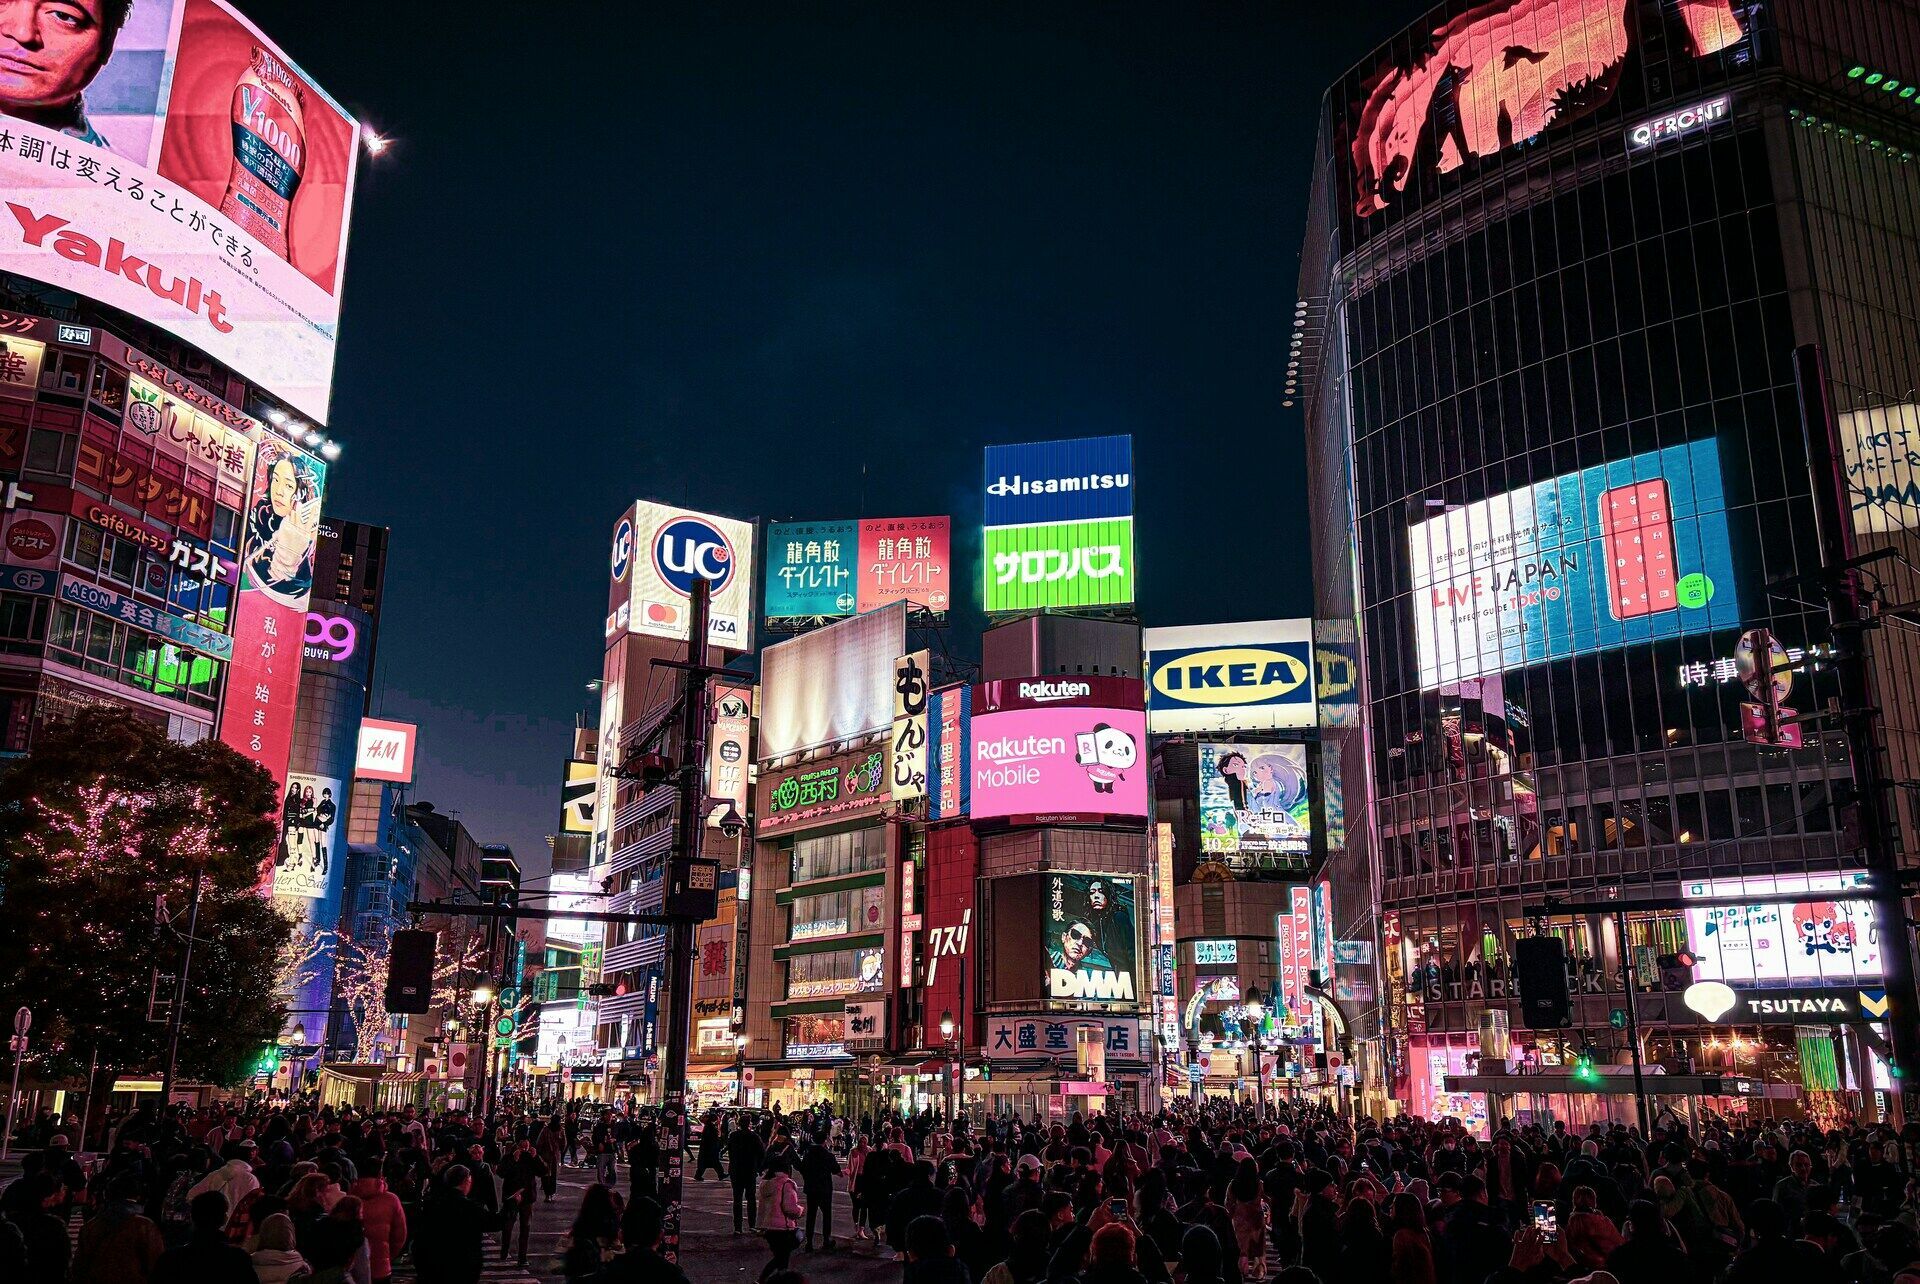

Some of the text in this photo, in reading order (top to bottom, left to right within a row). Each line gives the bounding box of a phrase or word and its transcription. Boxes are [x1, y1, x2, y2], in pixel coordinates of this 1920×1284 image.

[259, 79, 293, 113] Yakult
[242, 86, 301, 167] Y1000
[7, 202, 234, 334] Yakult
[60, 328, 90, 343] 寿司
[125, 347, 257, 434] しゃぶしゃぶバイキング
[169, 412, 246, 475] しゃぶ葉
[0, 481, 33, 509] ト
[78, 443, 208, 525] コンタクト
[986, 473, 1130, 498] Hisamitsu
[12, 535, 50, 550] ガスト
[89, 506, 167, 552] Caféレストラン
[317, 530, 339, 540] DIGO
[170, 540, 227, 580] ガスト
[786, 539, 841, 565] 龍角散
[878, 535, 933, 562] 龍角散
[778, 566, 850, 590] ダイレクト
[869, 562, 943, 586] ダイレクト
[992, 544, 1125, 586] サロンパス
[17, 573, 41, 589] 6F
[1433, 552, 1578, 609] LIVE JAPAN
[70, 584, 231, 653] AEON 英会話 イーオン
[1450, 586, 1560, 626] PRFECT GUDE TOKYO
[303, 612, 356, 663] 09
[304, 646, 329, 660] BUYA
[1019, 680, 1091, 699] Rakuten
[1166, 661, 1298, 691] IKEA
[249, 616, 278, 768] 私が、始まる。
[894, 657, 926, 793] もんじゃ
[368, 740, 400, 761] H&M
[941, 695, 956, 811] 三千里薬品
[977, 736, 1066, 761] Rakuten
[800, 777, 839, 806] 西村
[977, 766, 1041, 790] Mobile
[1051, 876, 1065, 922] 外道の歌
[1295, 896, 1309, 958] カラオケ
[1197, 953, 1236, 963] クリニック
[1050, 968, 1135, 1000] DMM
[1431, 972, 1626, 1001] STARBCKS
[1748, 998, 1848, 1014] TSUTAYA
[994, 1024, 1129, 1051] 大盛堂店
